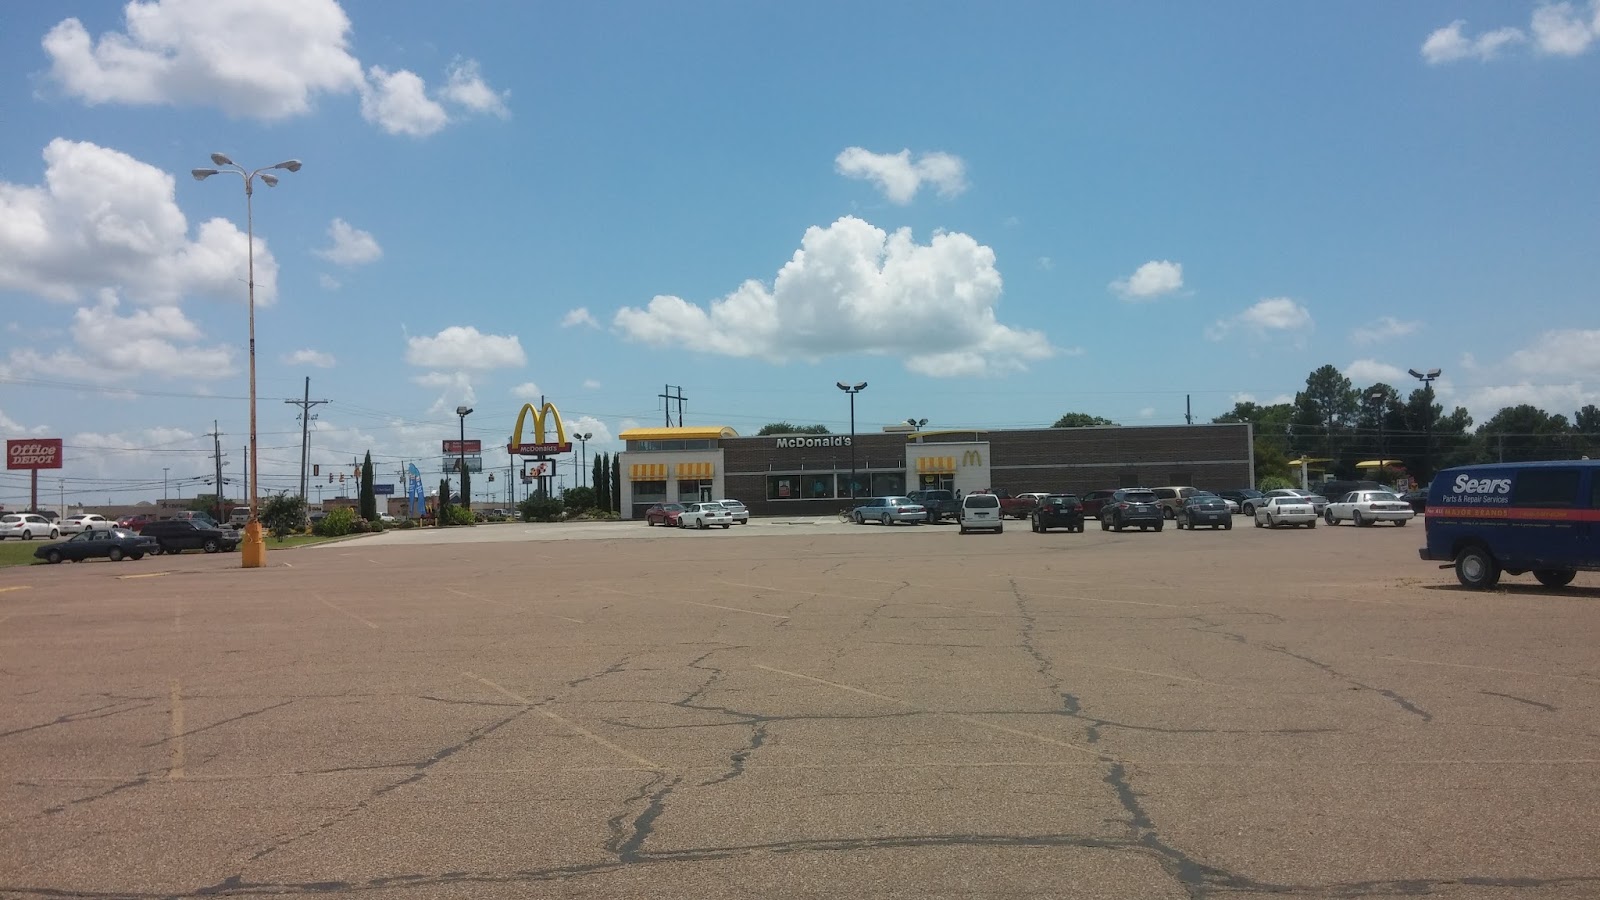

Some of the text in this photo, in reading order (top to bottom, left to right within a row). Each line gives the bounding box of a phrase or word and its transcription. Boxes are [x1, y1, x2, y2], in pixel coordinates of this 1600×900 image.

[776, 436, 852, 448] McDonald's
[10, 444, 56, 456] Office
[11, 455, 55, 464] DEPOT
[1452, 473, 1512, 494] Sears
[1442, 494, 1509, 504] Parts & Repair Services
[1444, 508, 1472, 516] MAJOR
[1475, 508, 1508, 516] BRANDS
